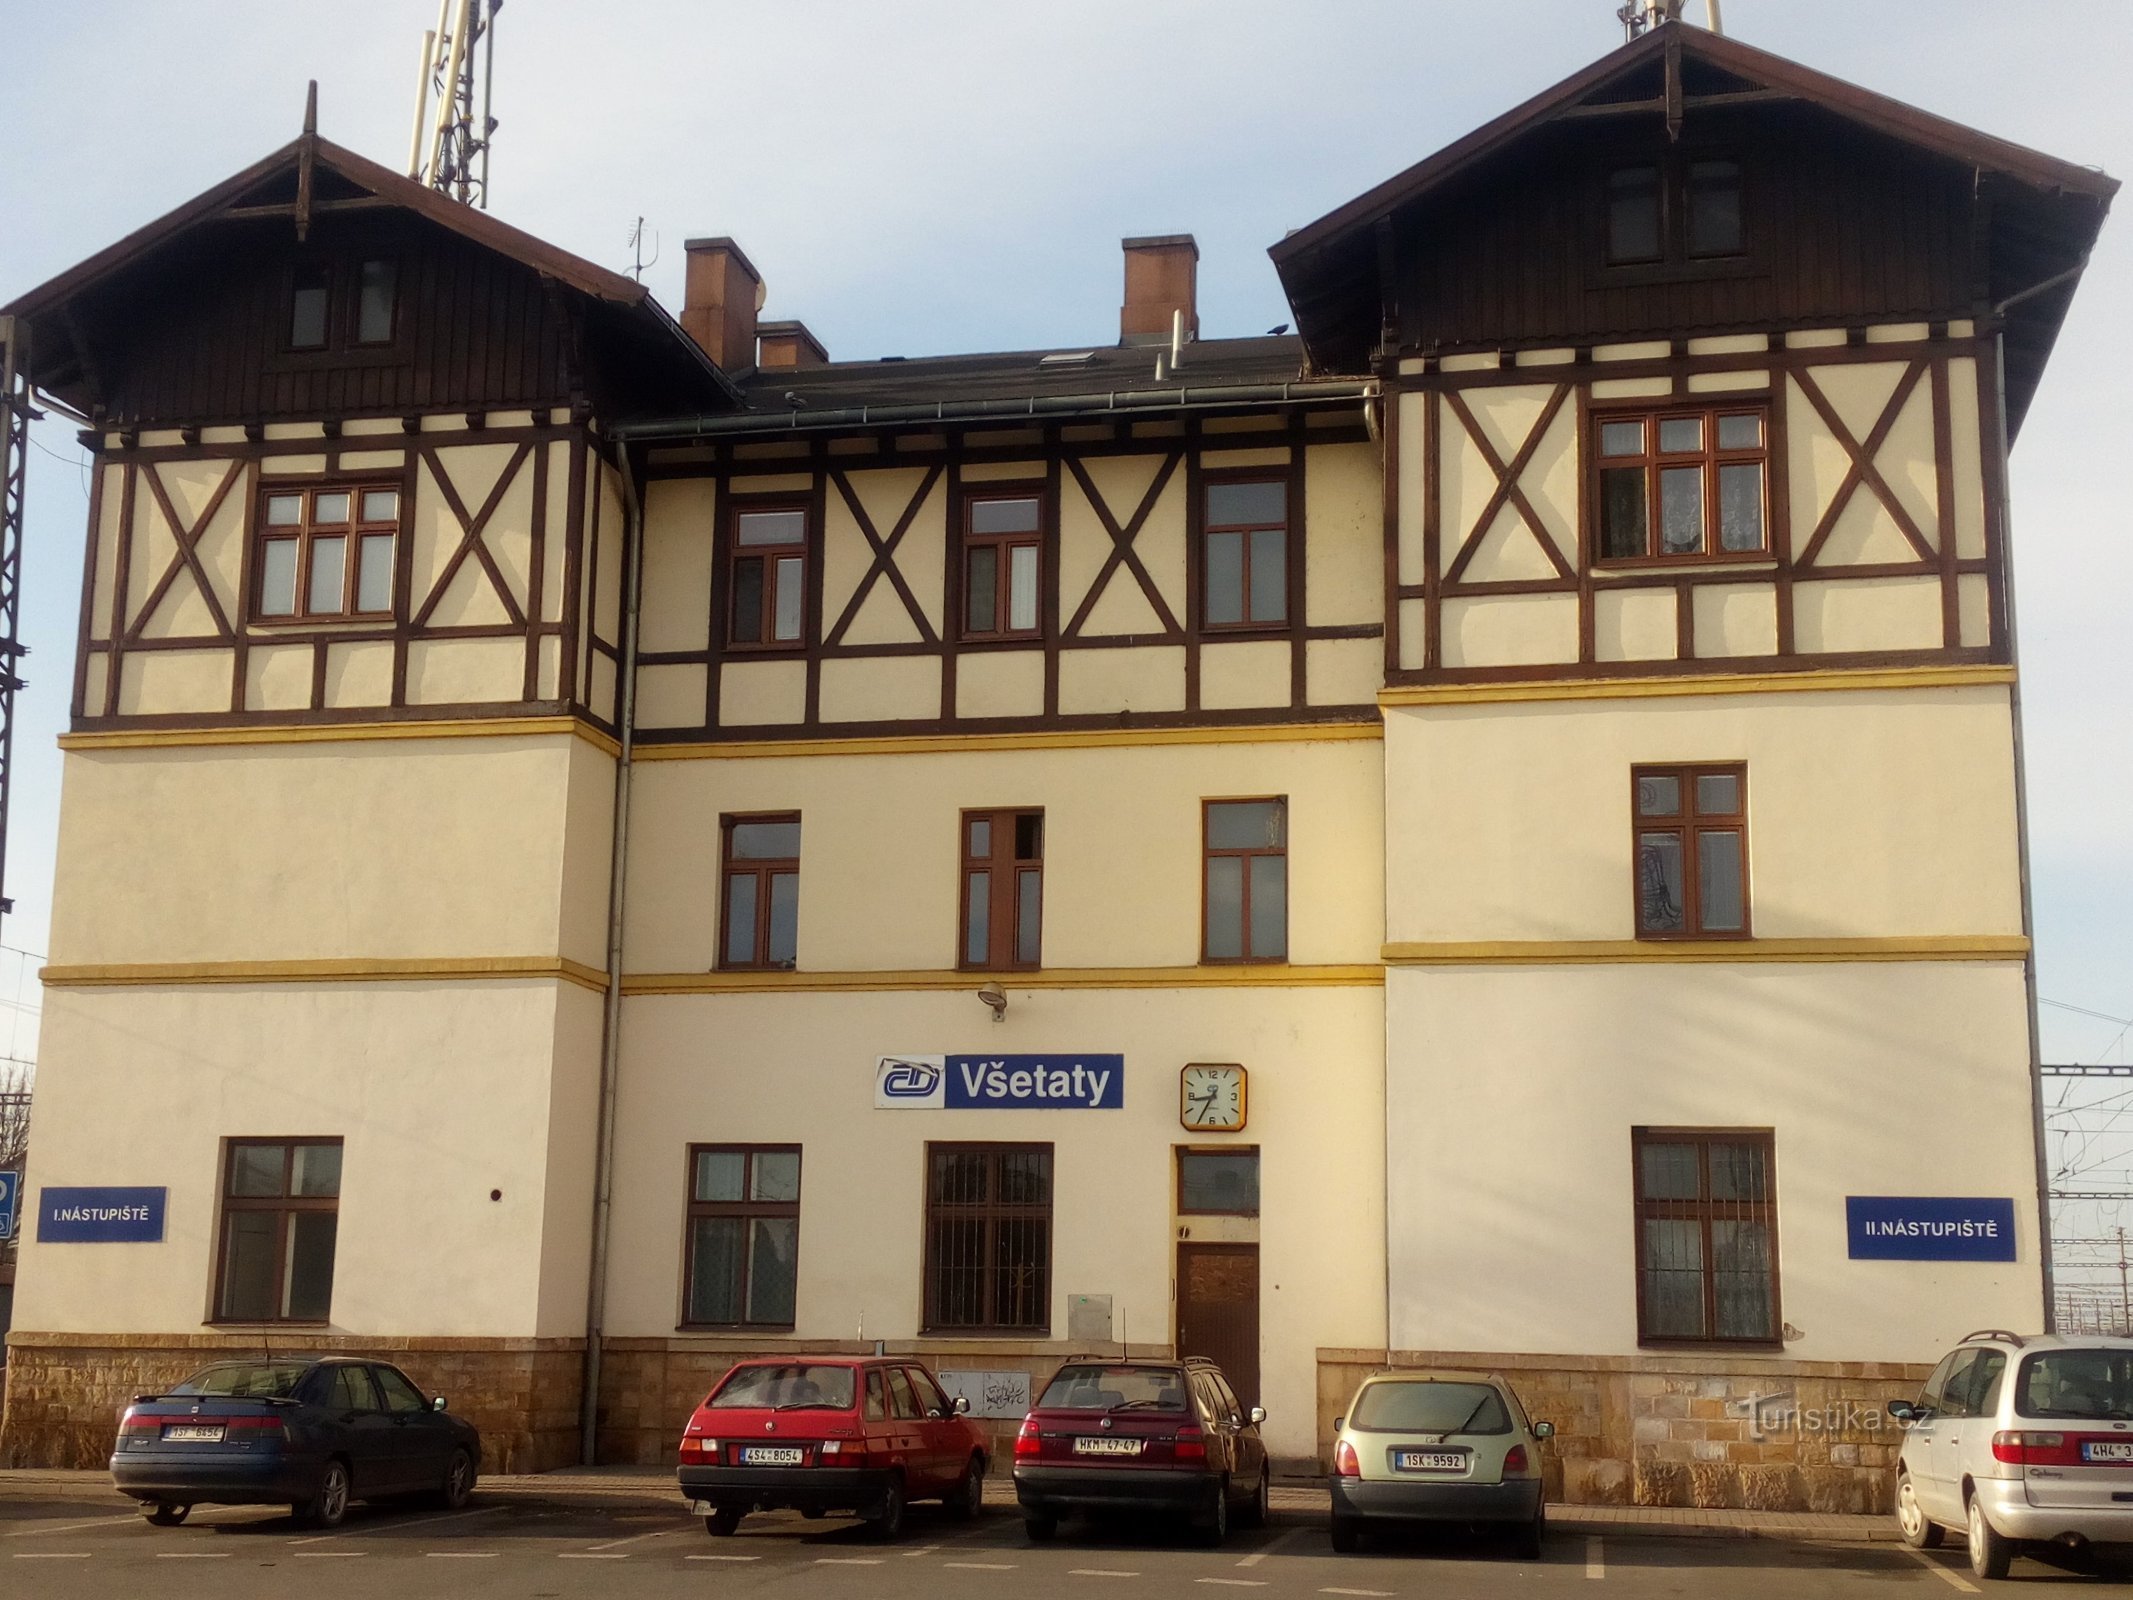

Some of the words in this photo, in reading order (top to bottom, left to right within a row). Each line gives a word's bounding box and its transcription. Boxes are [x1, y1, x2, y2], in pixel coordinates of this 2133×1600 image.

[1208, 1070, 1218, 1079] 12
[960, 1061, 1110, 1107] Všetaty
[1231, 1092, 1238, 1101] 3
[1209, 1116, 1216, 1125] 6
[1080, 1438, 1100, 1450] HKM
[1107, 1440, 1136, 1451] 47-47
[747, 1449, 766, 1461] 4S4
[773, 1450, 798, 1462] 8054
[2092, 1445, 2115, 1457] 4H4
[1406, 1454, 1425, 1467] 1SK
[1433, 1455, 1460, 1468] 9592
